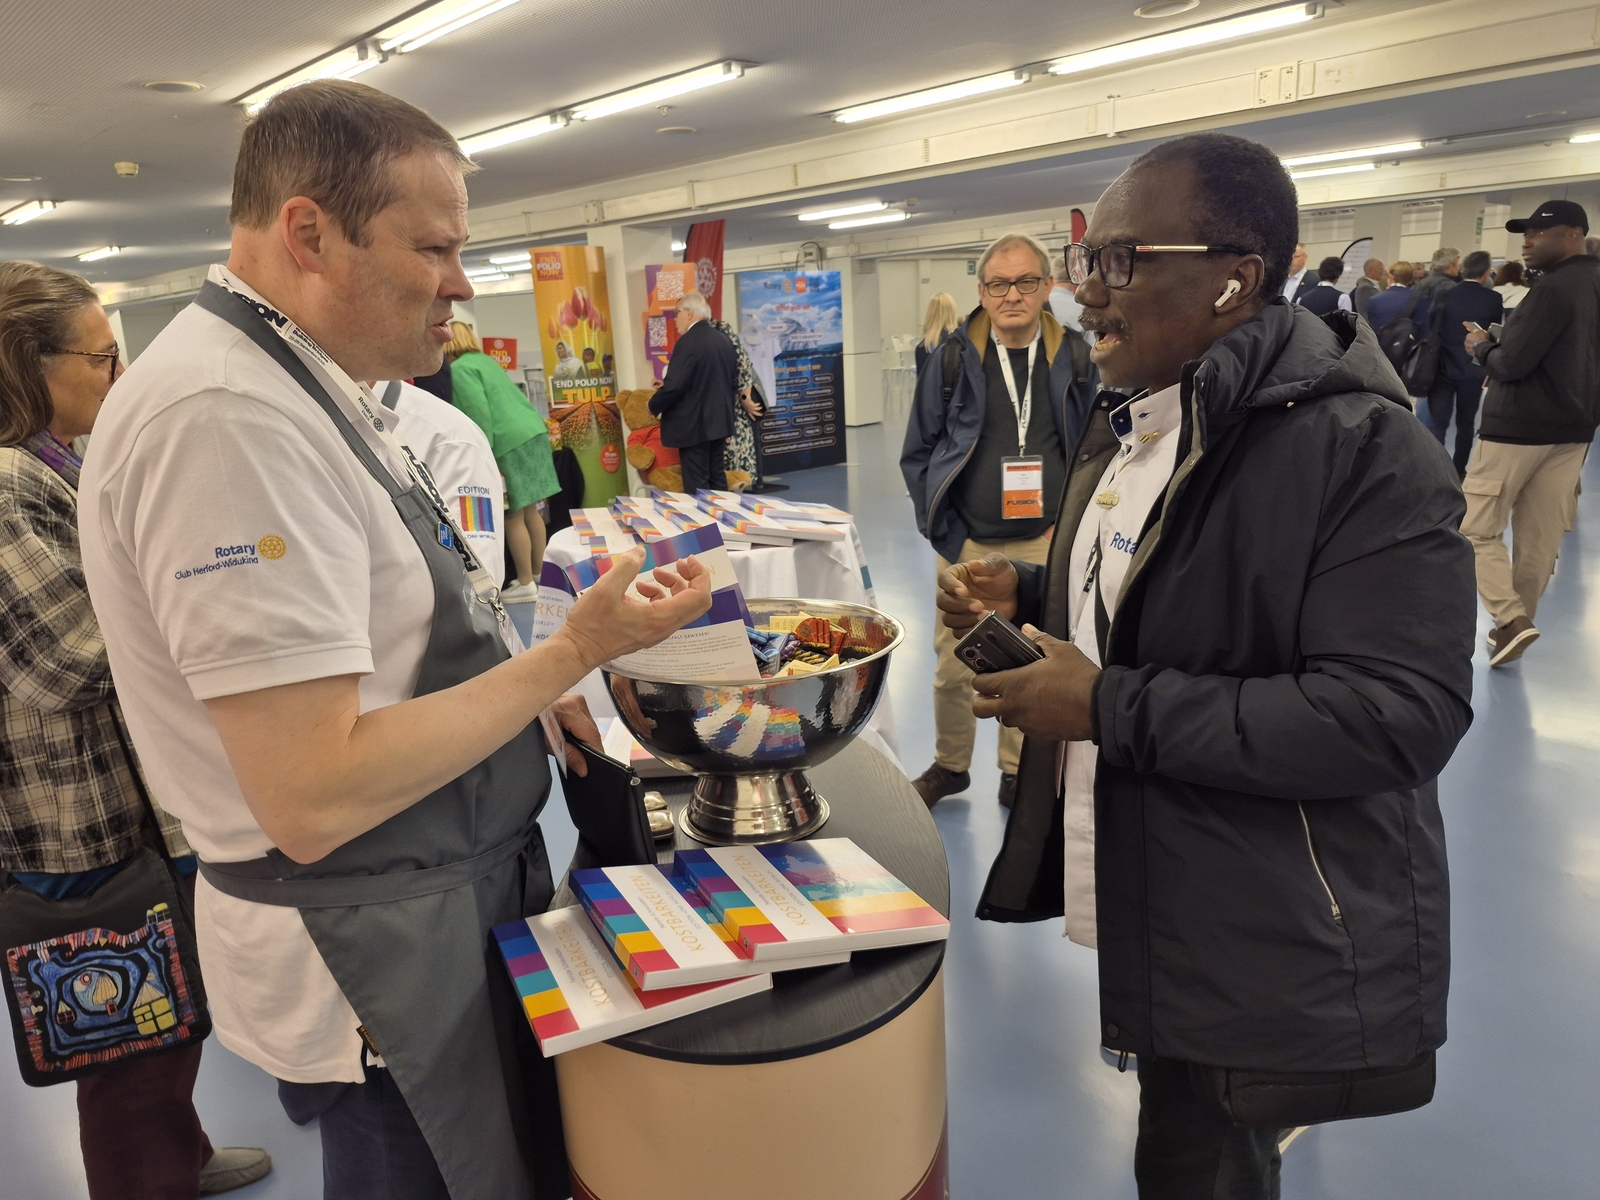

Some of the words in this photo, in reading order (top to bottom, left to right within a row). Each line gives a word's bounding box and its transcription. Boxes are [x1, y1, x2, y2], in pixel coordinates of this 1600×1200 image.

[537, 262, 561, 270] POLIO
[575, 378, 598, 387] POLIO
[562, 386, 612, 404] TULP
[358, 396, 374, 418] Rotary
[400, 446, 450, 512] FUSION
[458, 486, 490, 494] EDITION
[215, 544, 255, 559] Rotary
[175, 571, 192, 580] Club
[193, 556, 259, 576] Herford-Widukind
[731, 855, 810, 926] KOSTBARKEITEN
[629, 875, 705, 952] KOSTBARKEITEN
[552, 920, 612, 1006] KOSTBARKEITEN
